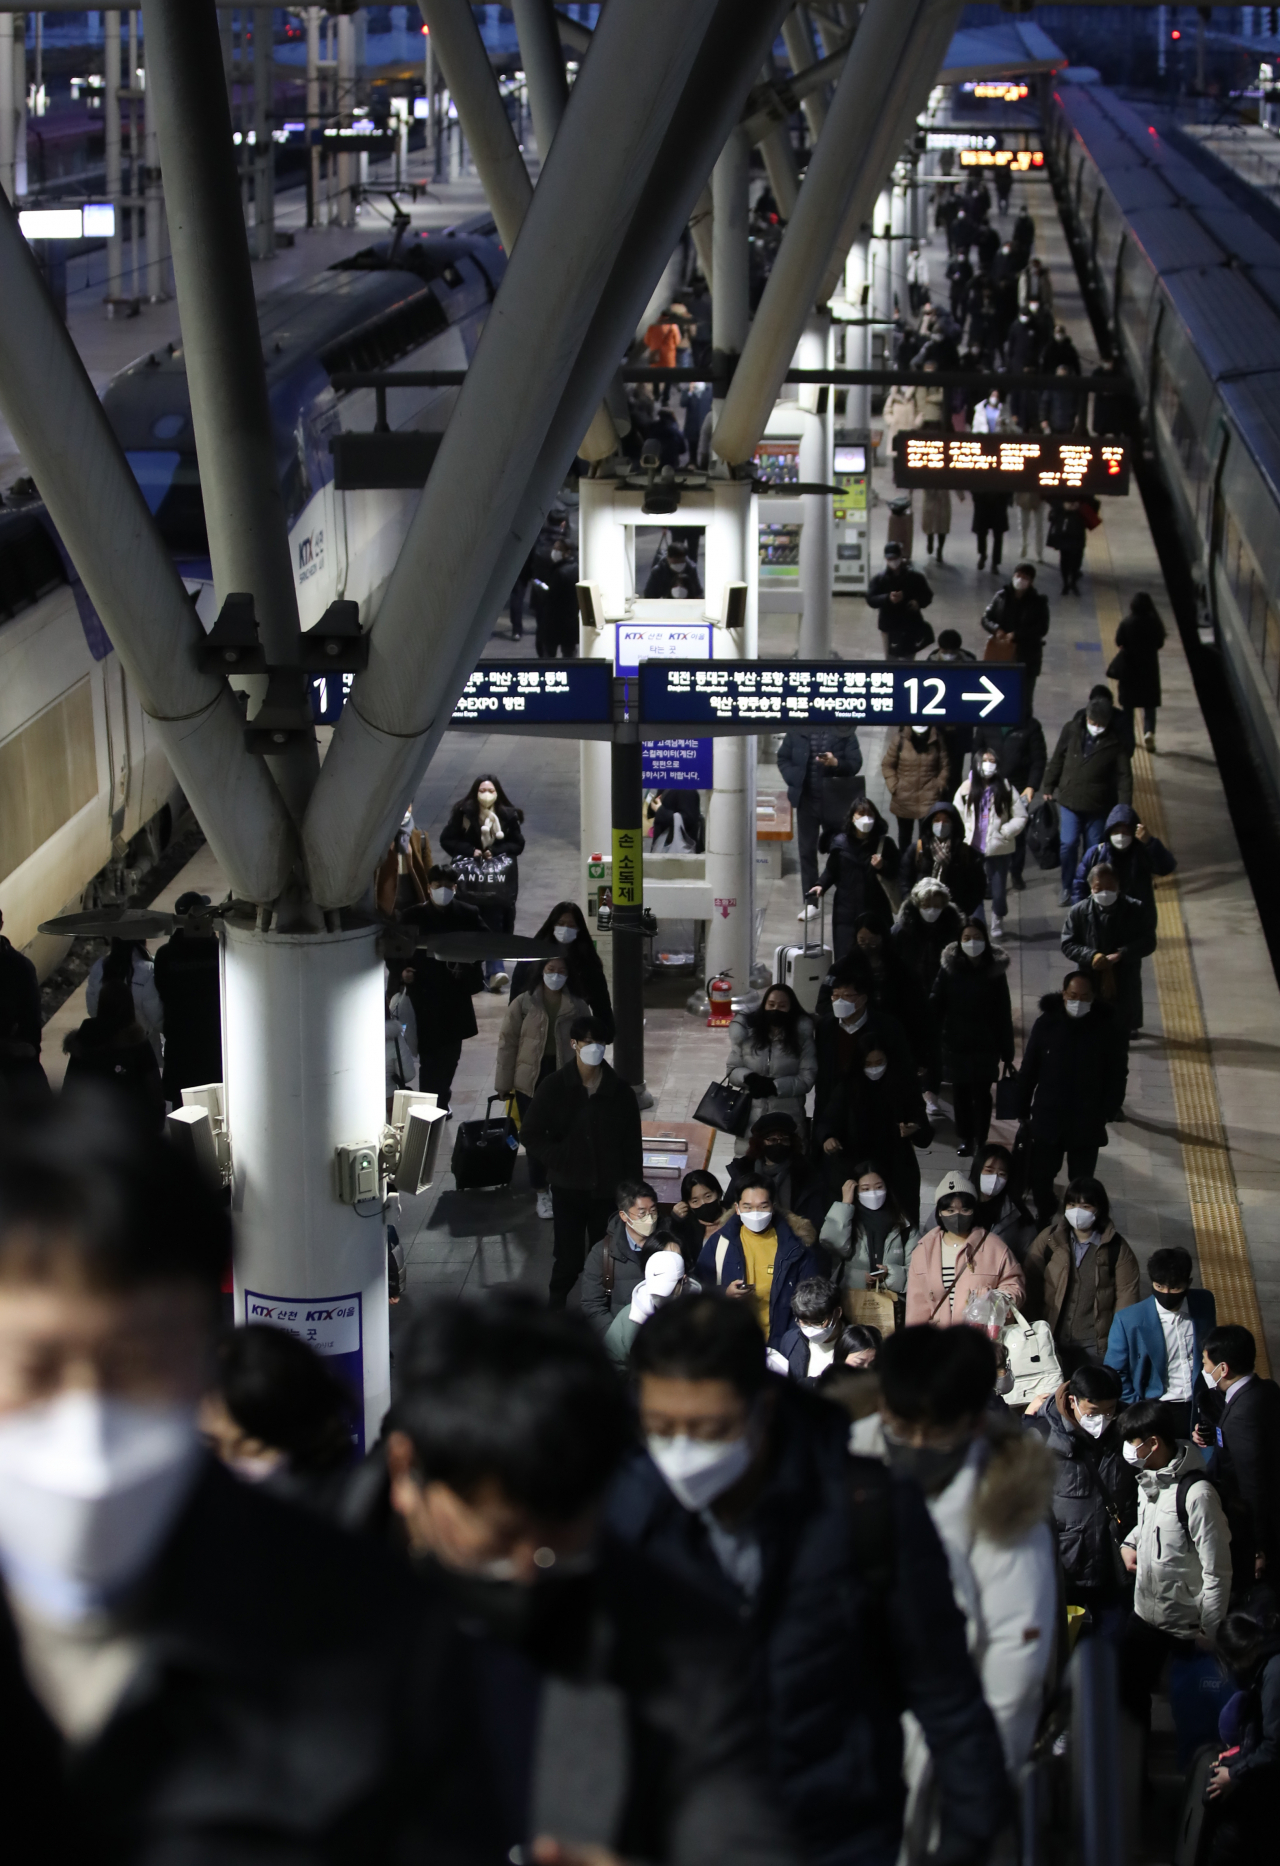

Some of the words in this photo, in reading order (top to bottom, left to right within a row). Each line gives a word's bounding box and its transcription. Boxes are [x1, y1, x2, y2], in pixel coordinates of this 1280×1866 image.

[299, 527, 314, 570] KTX
[625, 631, 648, 640] KTX
[668, 631, 692, 640] KTX
[650, 645, 665, 654] 타는
[669, 645, 676, 654] 곳
[904, 677, 947, 715] 12
[502, 697, 525, 711] 방면
[870, 697, 894, 711] 방면
[642, 749, 697, 758] 스컬레이터(계단)
[618, 833, 634, 849] 손
[618, 855, 635, 902] 소독제
[252, 1304, 279, 1319] KTX
[277, 1310, 298, 1321] 산천
[305, 1306, 341, 1322] KTX
[306, 1328, 317, 1341] 곳
